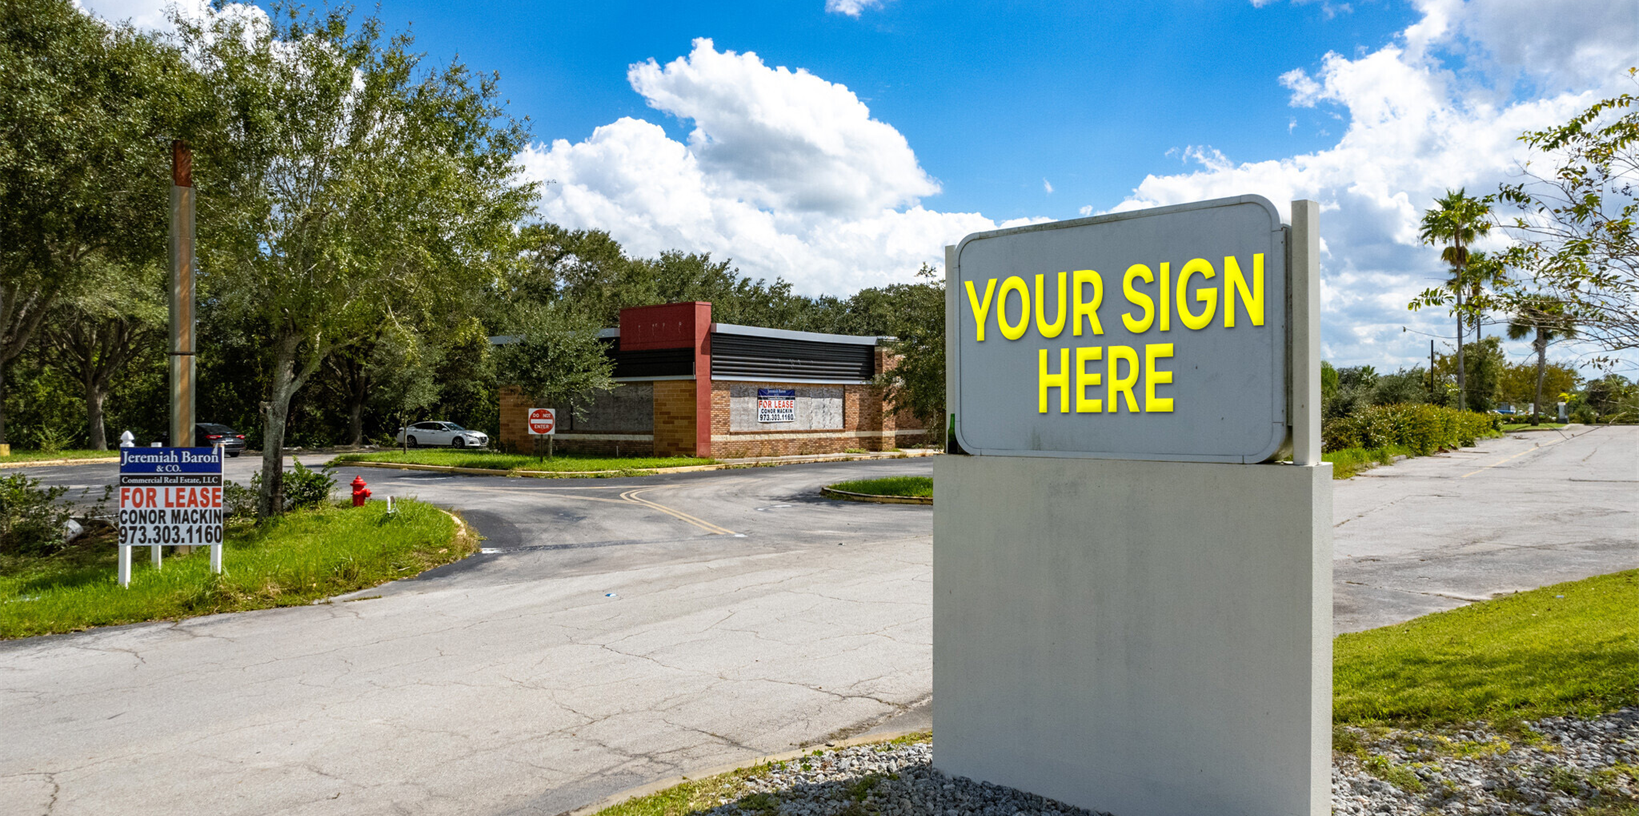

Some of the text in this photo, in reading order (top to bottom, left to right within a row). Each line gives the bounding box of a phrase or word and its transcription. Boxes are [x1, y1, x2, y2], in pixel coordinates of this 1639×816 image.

[964, 252, 1265, 342] YOUR SIGN
[1038, 342, 1175, 414] HERE
[774, 400, 794, 408] LEASE
[121, 450, 219, 466] Jeremiah Baron
[121, 488, 222, 508] FOR LEASE
[120, 509, 222, 524] CONOR MACKIN
[120, 525, 222, 544] 973.303.1160
